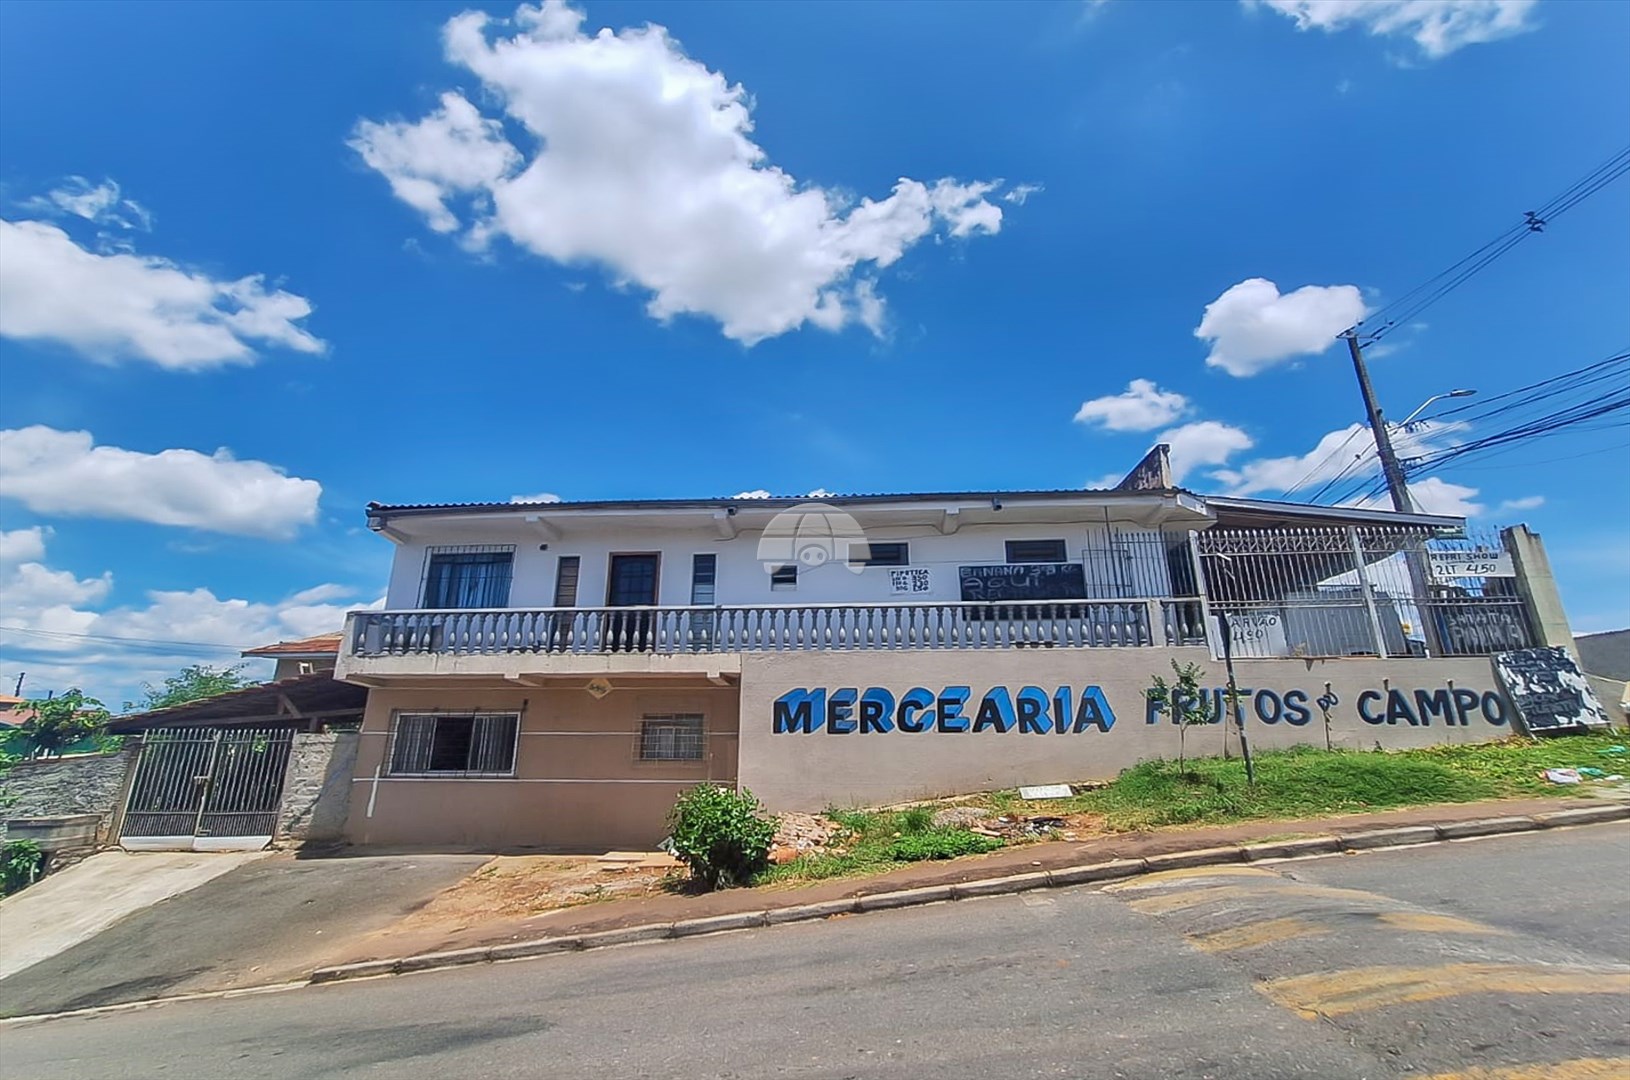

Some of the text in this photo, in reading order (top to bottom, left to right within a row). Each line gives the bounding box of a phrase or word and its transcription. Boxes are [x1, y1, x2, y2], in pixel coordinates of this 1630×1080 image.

[1466, 552, 1498, 560] SHOW
[772, 685, 1117, 735] MERCEARIA
[1357, 687, 1508, 727] CAMPO
